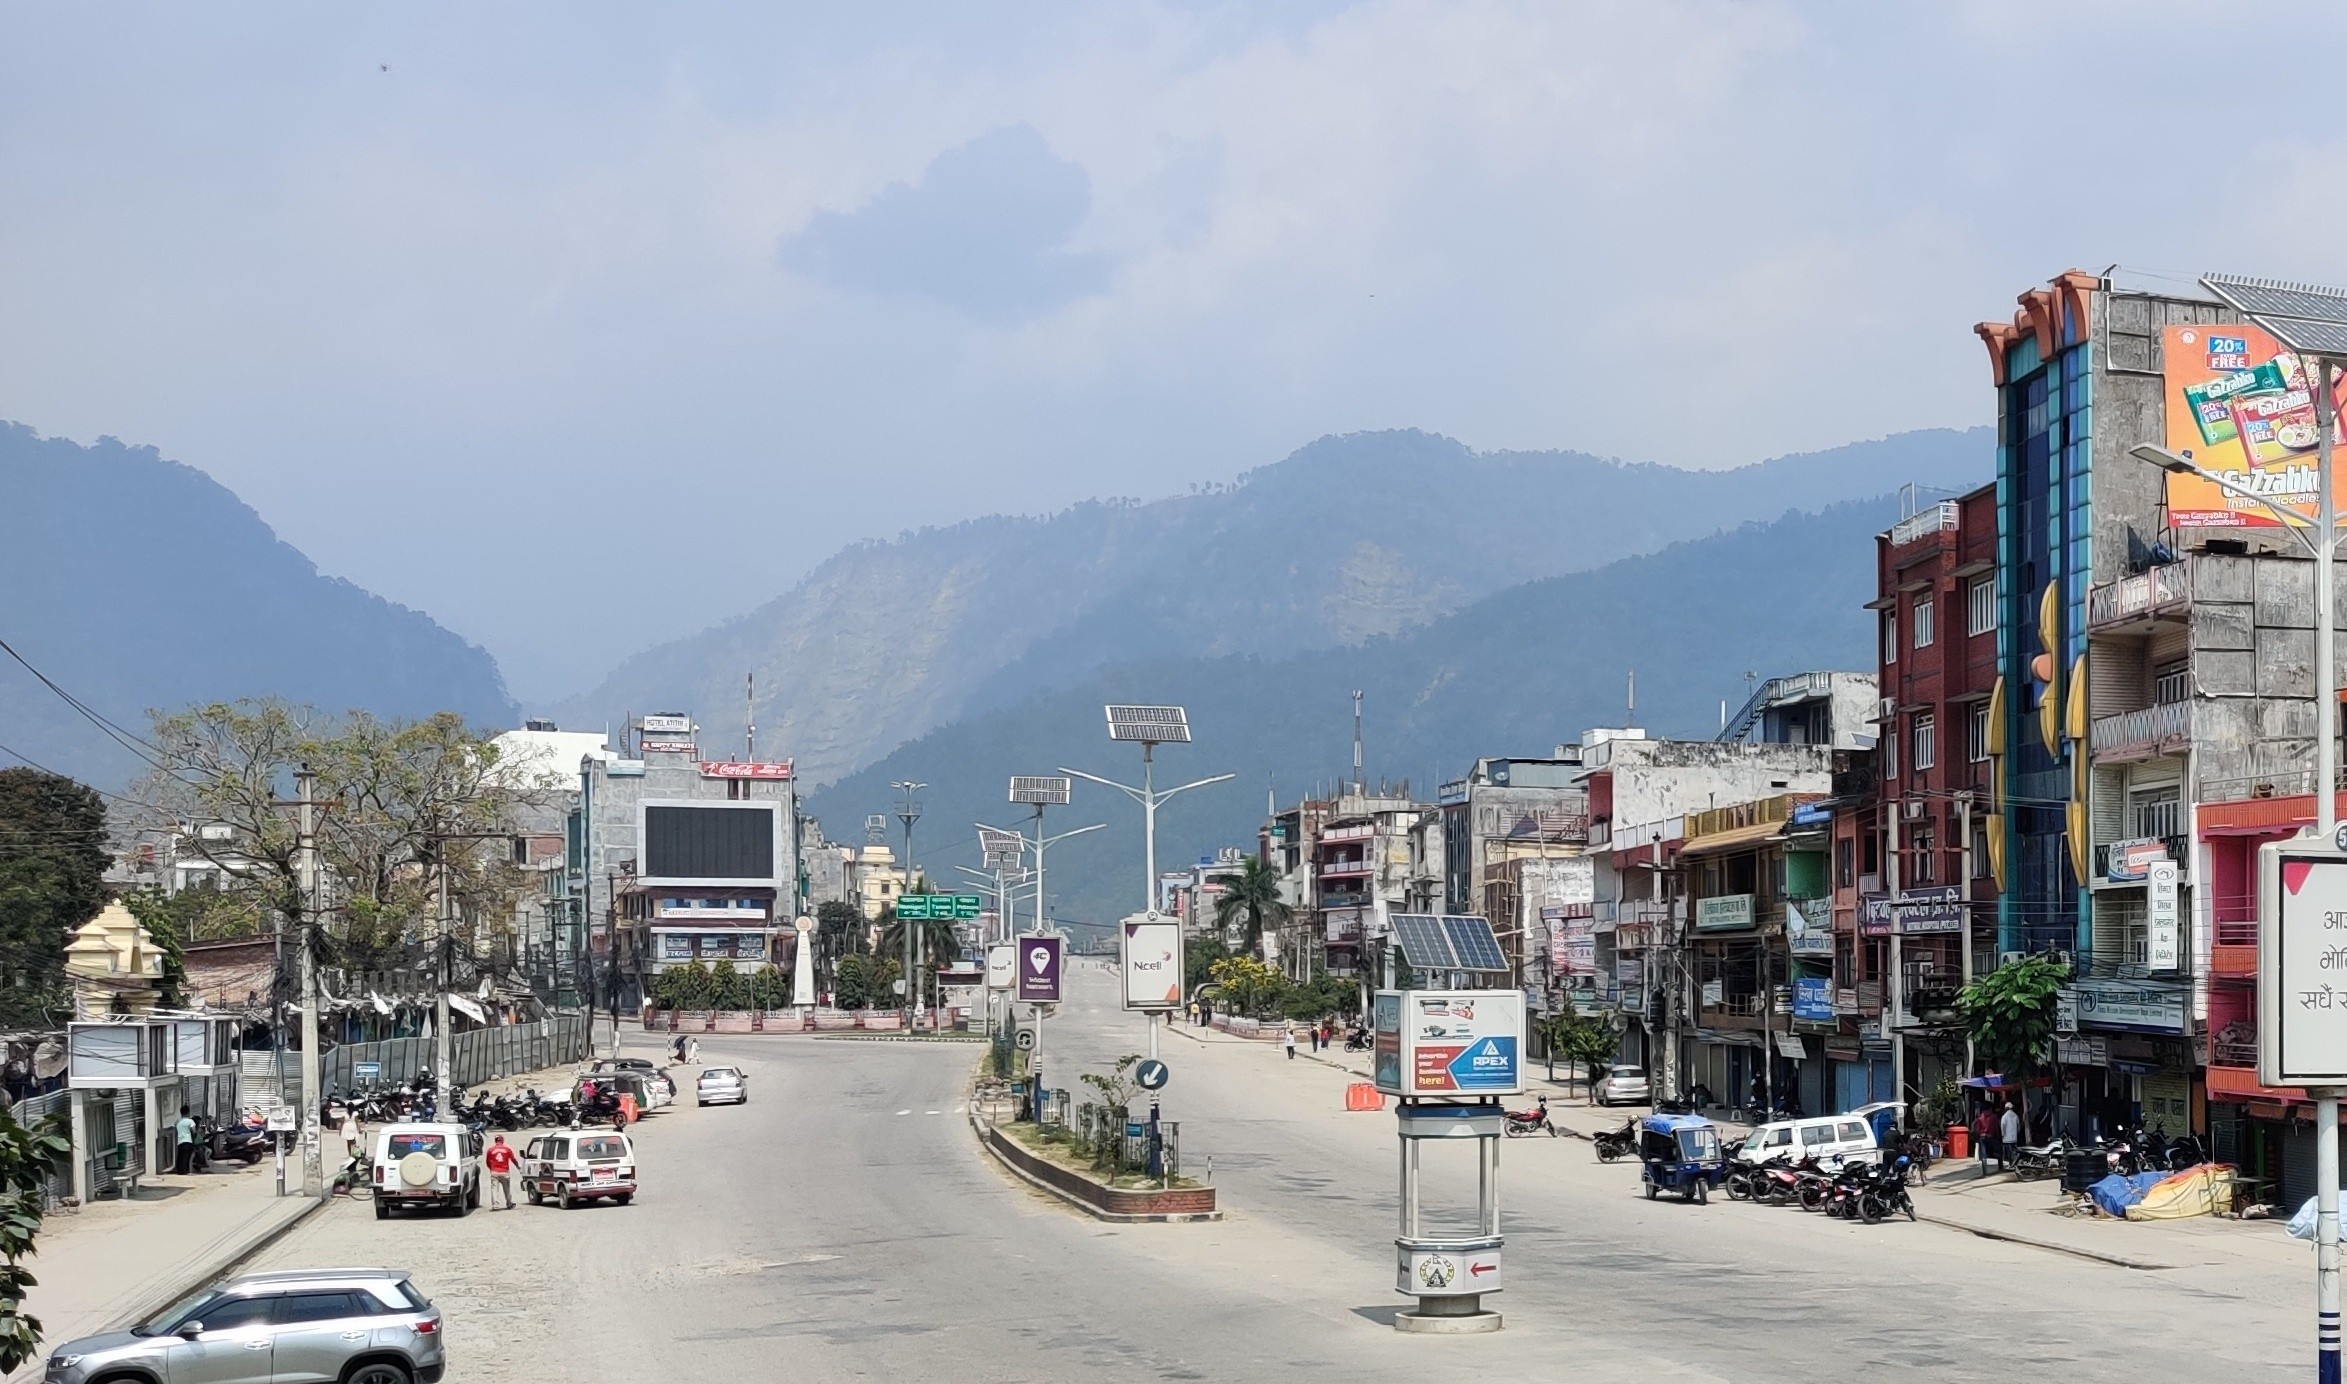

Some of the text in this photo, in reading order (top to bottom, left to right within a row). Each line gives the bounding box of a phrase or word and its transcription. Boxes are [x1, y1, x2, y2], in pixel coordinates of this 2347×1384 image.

[2211, 355, 2246, 368] FREE
[1134, 961, 1161, 971] Ncell
[1472, 1056, 1509, 1067] APEX
